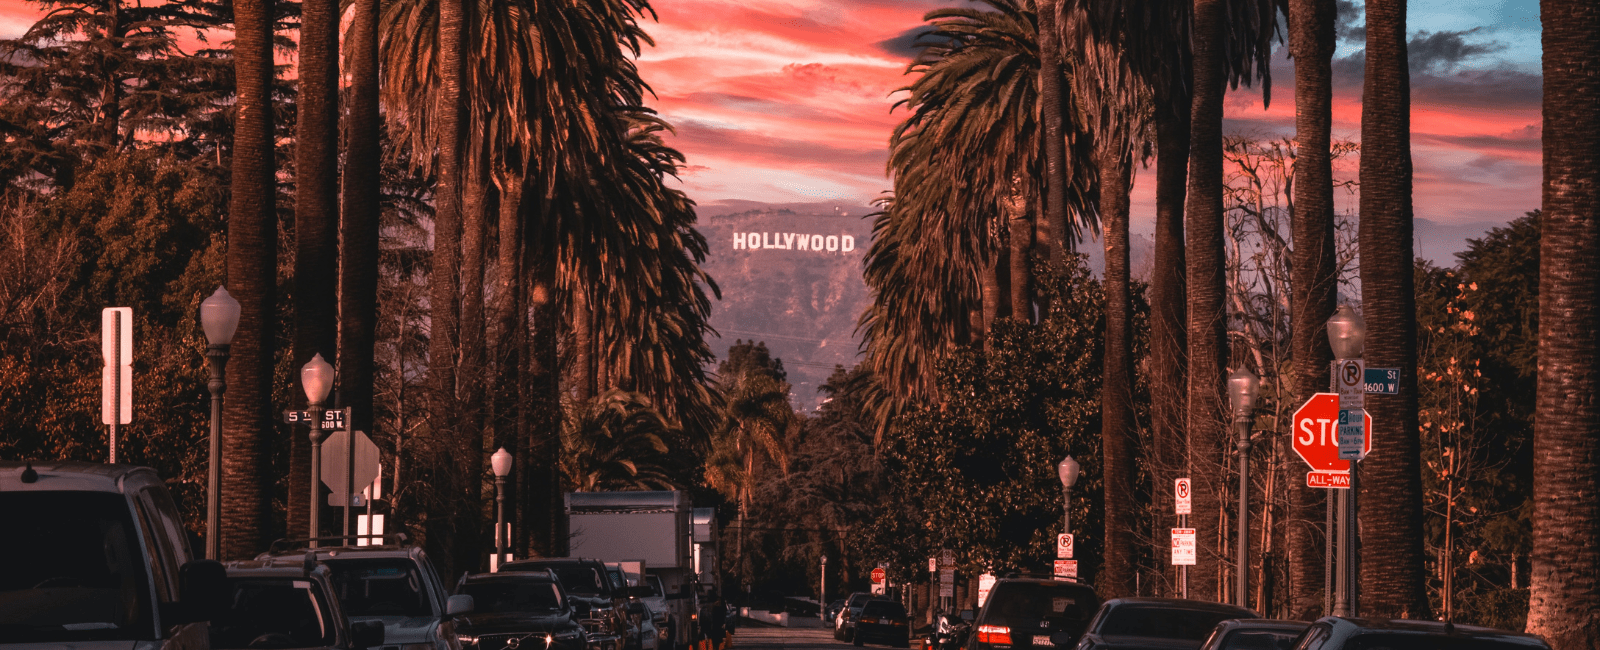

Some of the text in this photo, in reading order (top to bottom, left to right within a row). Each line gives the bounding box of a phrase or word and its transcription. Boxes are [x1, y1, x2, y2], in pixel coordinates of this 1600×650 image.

[733, 232, 855, 252] HOLLYWOOD
[1387, 370, 1396, 380] St
[1363, 382, 1395, 392] 4600 W
[1340, 411, 1363, 422] 2 HOUR
[1299, 418, 1339, 446] STO
[1339, 426, 1363, 436] PARKING
